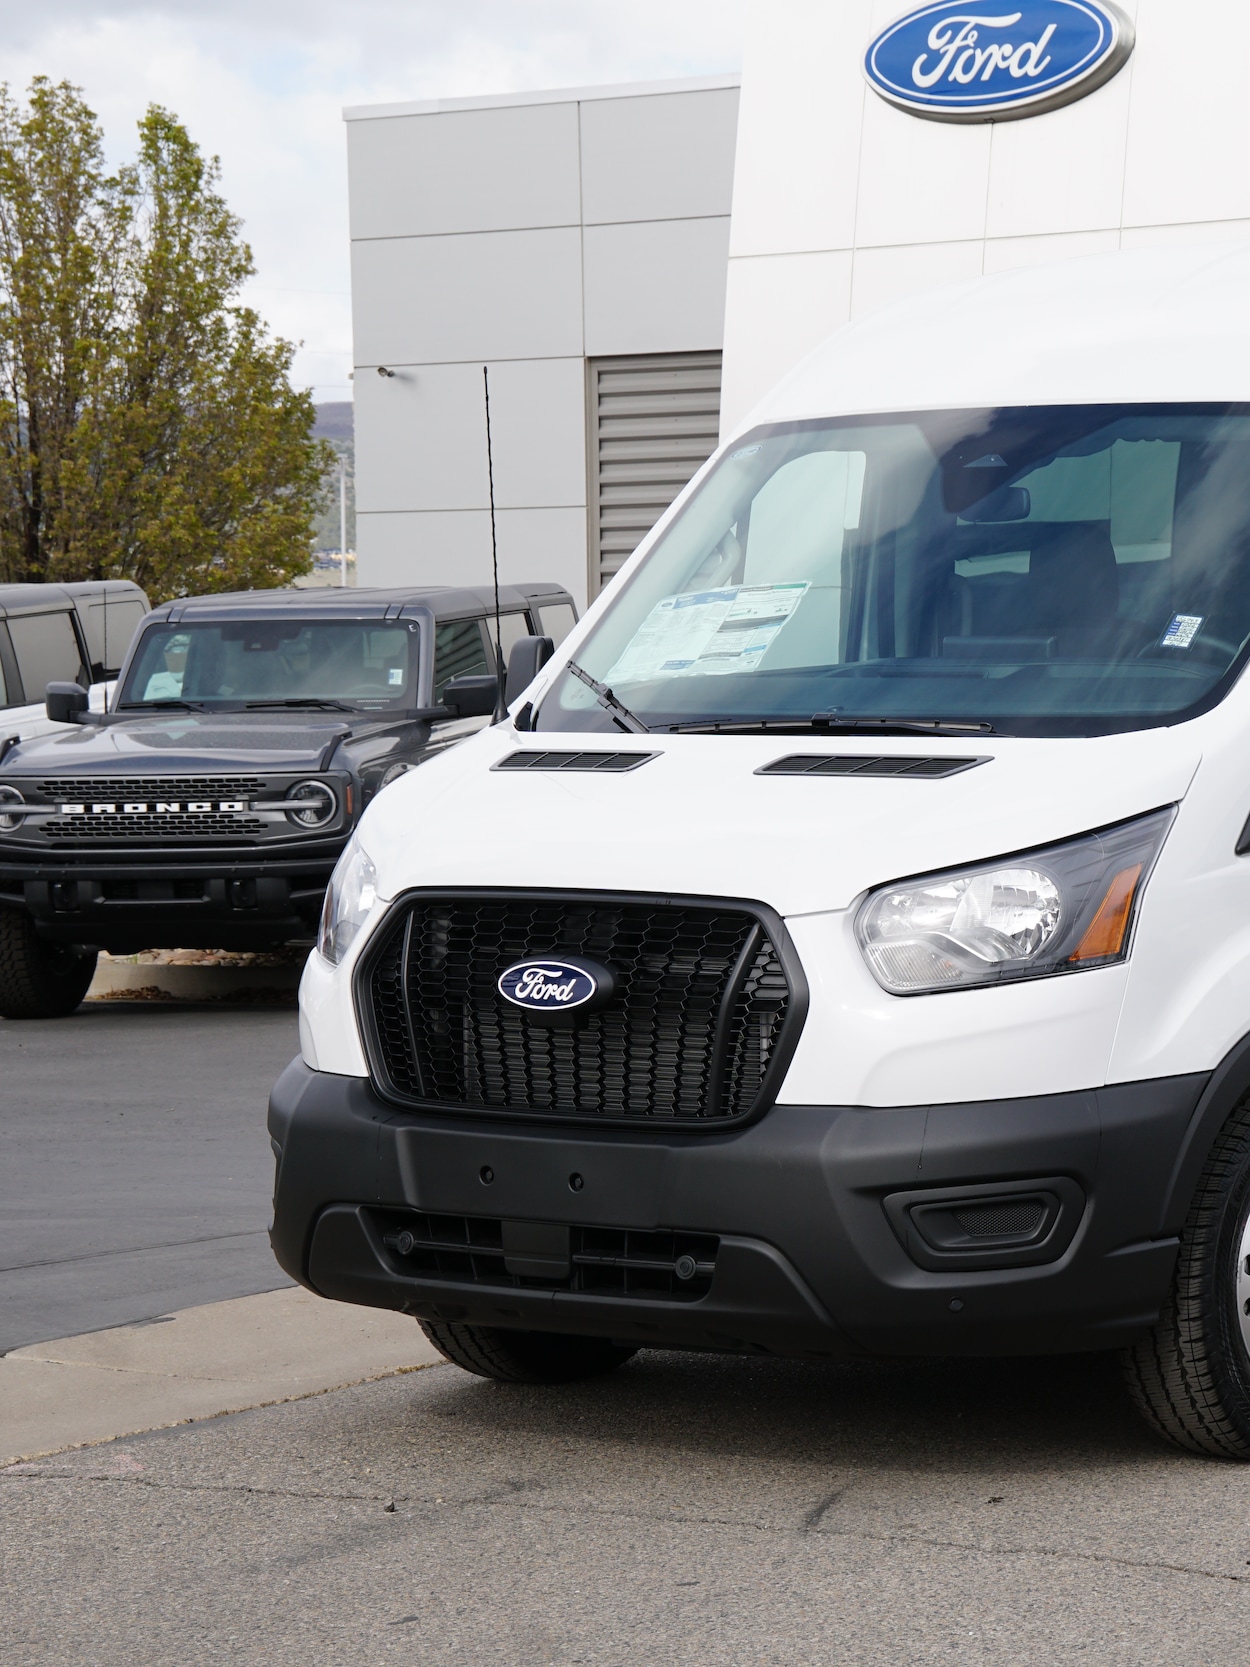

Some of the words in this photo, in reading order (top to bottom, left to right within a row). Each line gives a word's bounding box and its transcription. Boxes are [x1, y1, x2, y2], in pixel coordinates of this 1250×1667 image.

[911, 11, 1058, 88] Ford
[60, 801, 244, 815] BRONCO
[514, 967, 577, 1002] Ford
